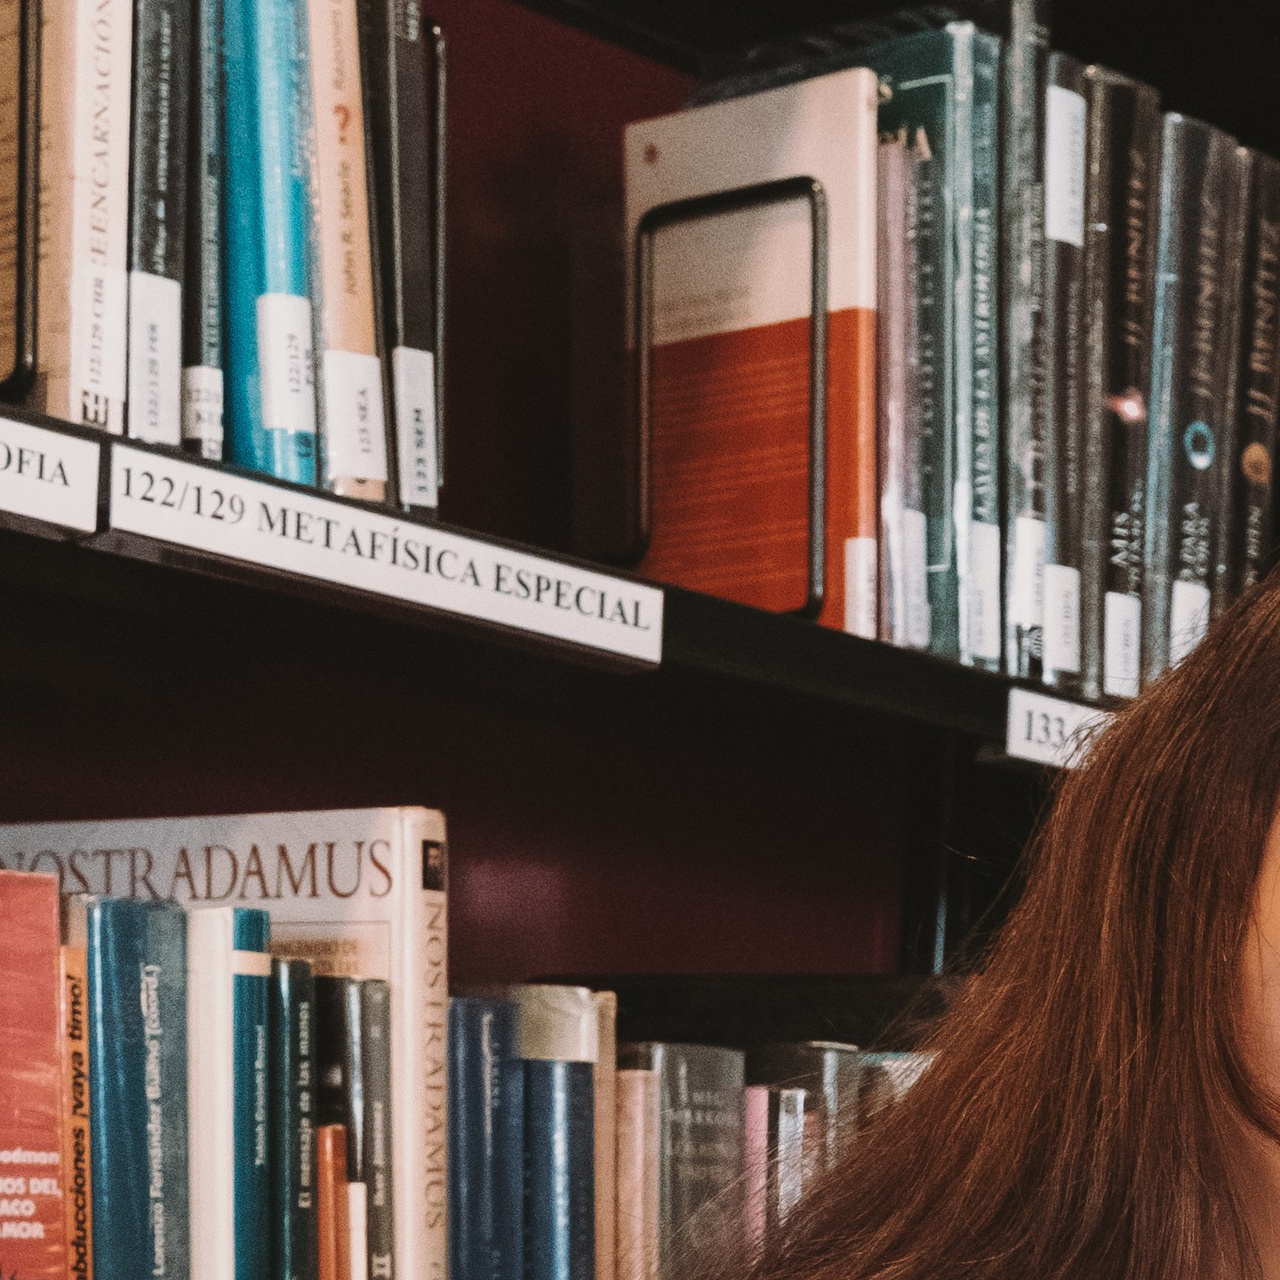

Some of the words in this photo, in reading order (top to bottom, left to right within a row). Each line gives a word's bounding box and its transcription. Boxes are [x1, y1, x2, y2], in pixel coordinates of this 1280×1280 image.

[120, 466, 245, 525] 122/129
[258, 501, 481, 588] METAFÍSICA
[494, 565, 651, 631] ESPECIAL
[65, 973, 84, 1041] timo!
[298, 1002, 310, 1055] manos
[69, 1051, 88, 1118] ¡vaya
[297, 1061, 310, 1085] las
[424, 902, 445, 1231] NOSTRADAMUS
[297, 1091, 310, 1112] de
[146, 1104, 163, 1198] Fernández
[297, 1118, 312, 1186] mensaje
[297, 1191, 311, 1208] El
[150, 1203, 165, 1275] Lorenzo
